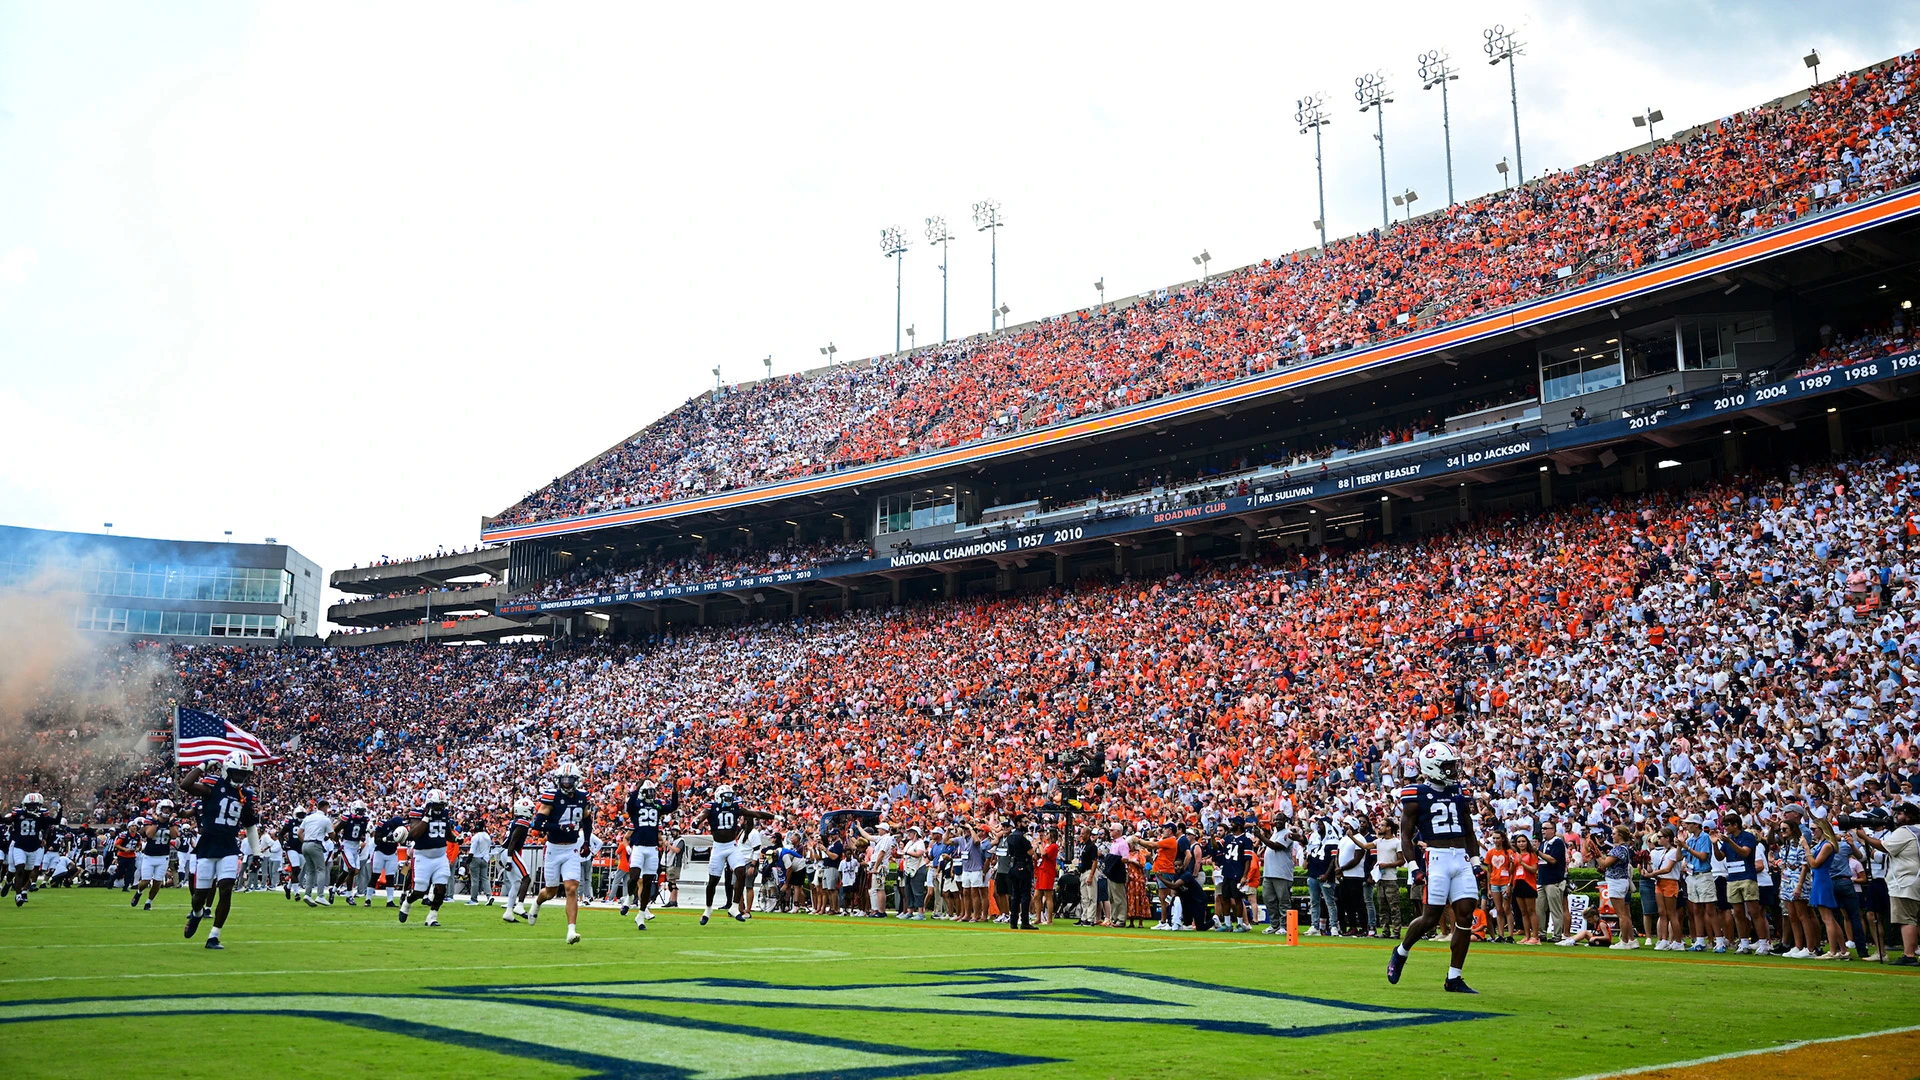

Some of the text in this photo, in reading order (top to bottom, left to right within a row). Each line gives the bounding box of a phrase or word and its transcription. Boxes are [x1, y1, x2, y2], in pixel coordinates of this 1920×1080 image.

[1628, 354, 1920, 430] 2013 2010 2004 1989 1988 198
[1446, 442, 1531, 468] 34 BO JACKSON
[1337, 464, 1422, 489] 88 TERRY BEASLEY
[1246, 486, 1313, 507] 7 PAT SULLIVAN
[1154, 502, 1227, 523] BROADWAY CLUB
[891, 526, 1083, 567] NATIONAL CHAMPIONS 1957 2010
[500, 570, 812, 614] PAT DYE FIELD UNDEFEATED SEASONS 1893 1897 1900 1904 1913 1914 1932 1957 1958 1993 2004 2010
[215, 797, 242, 827] 19
[639, 808, 658, 828] 29
[717, 812, 734, 830] 10
[1430, 802, 1462, 834] 21
[20, 820, 36, 836] 81
[152, 829, 171, 845] 46
[352, 825, 360, 838] 8
[428, 821, 446, 838] 55
[1225, 844, 1239, 861] 34
[1570, 898, 1586, 930] DEFENSE
